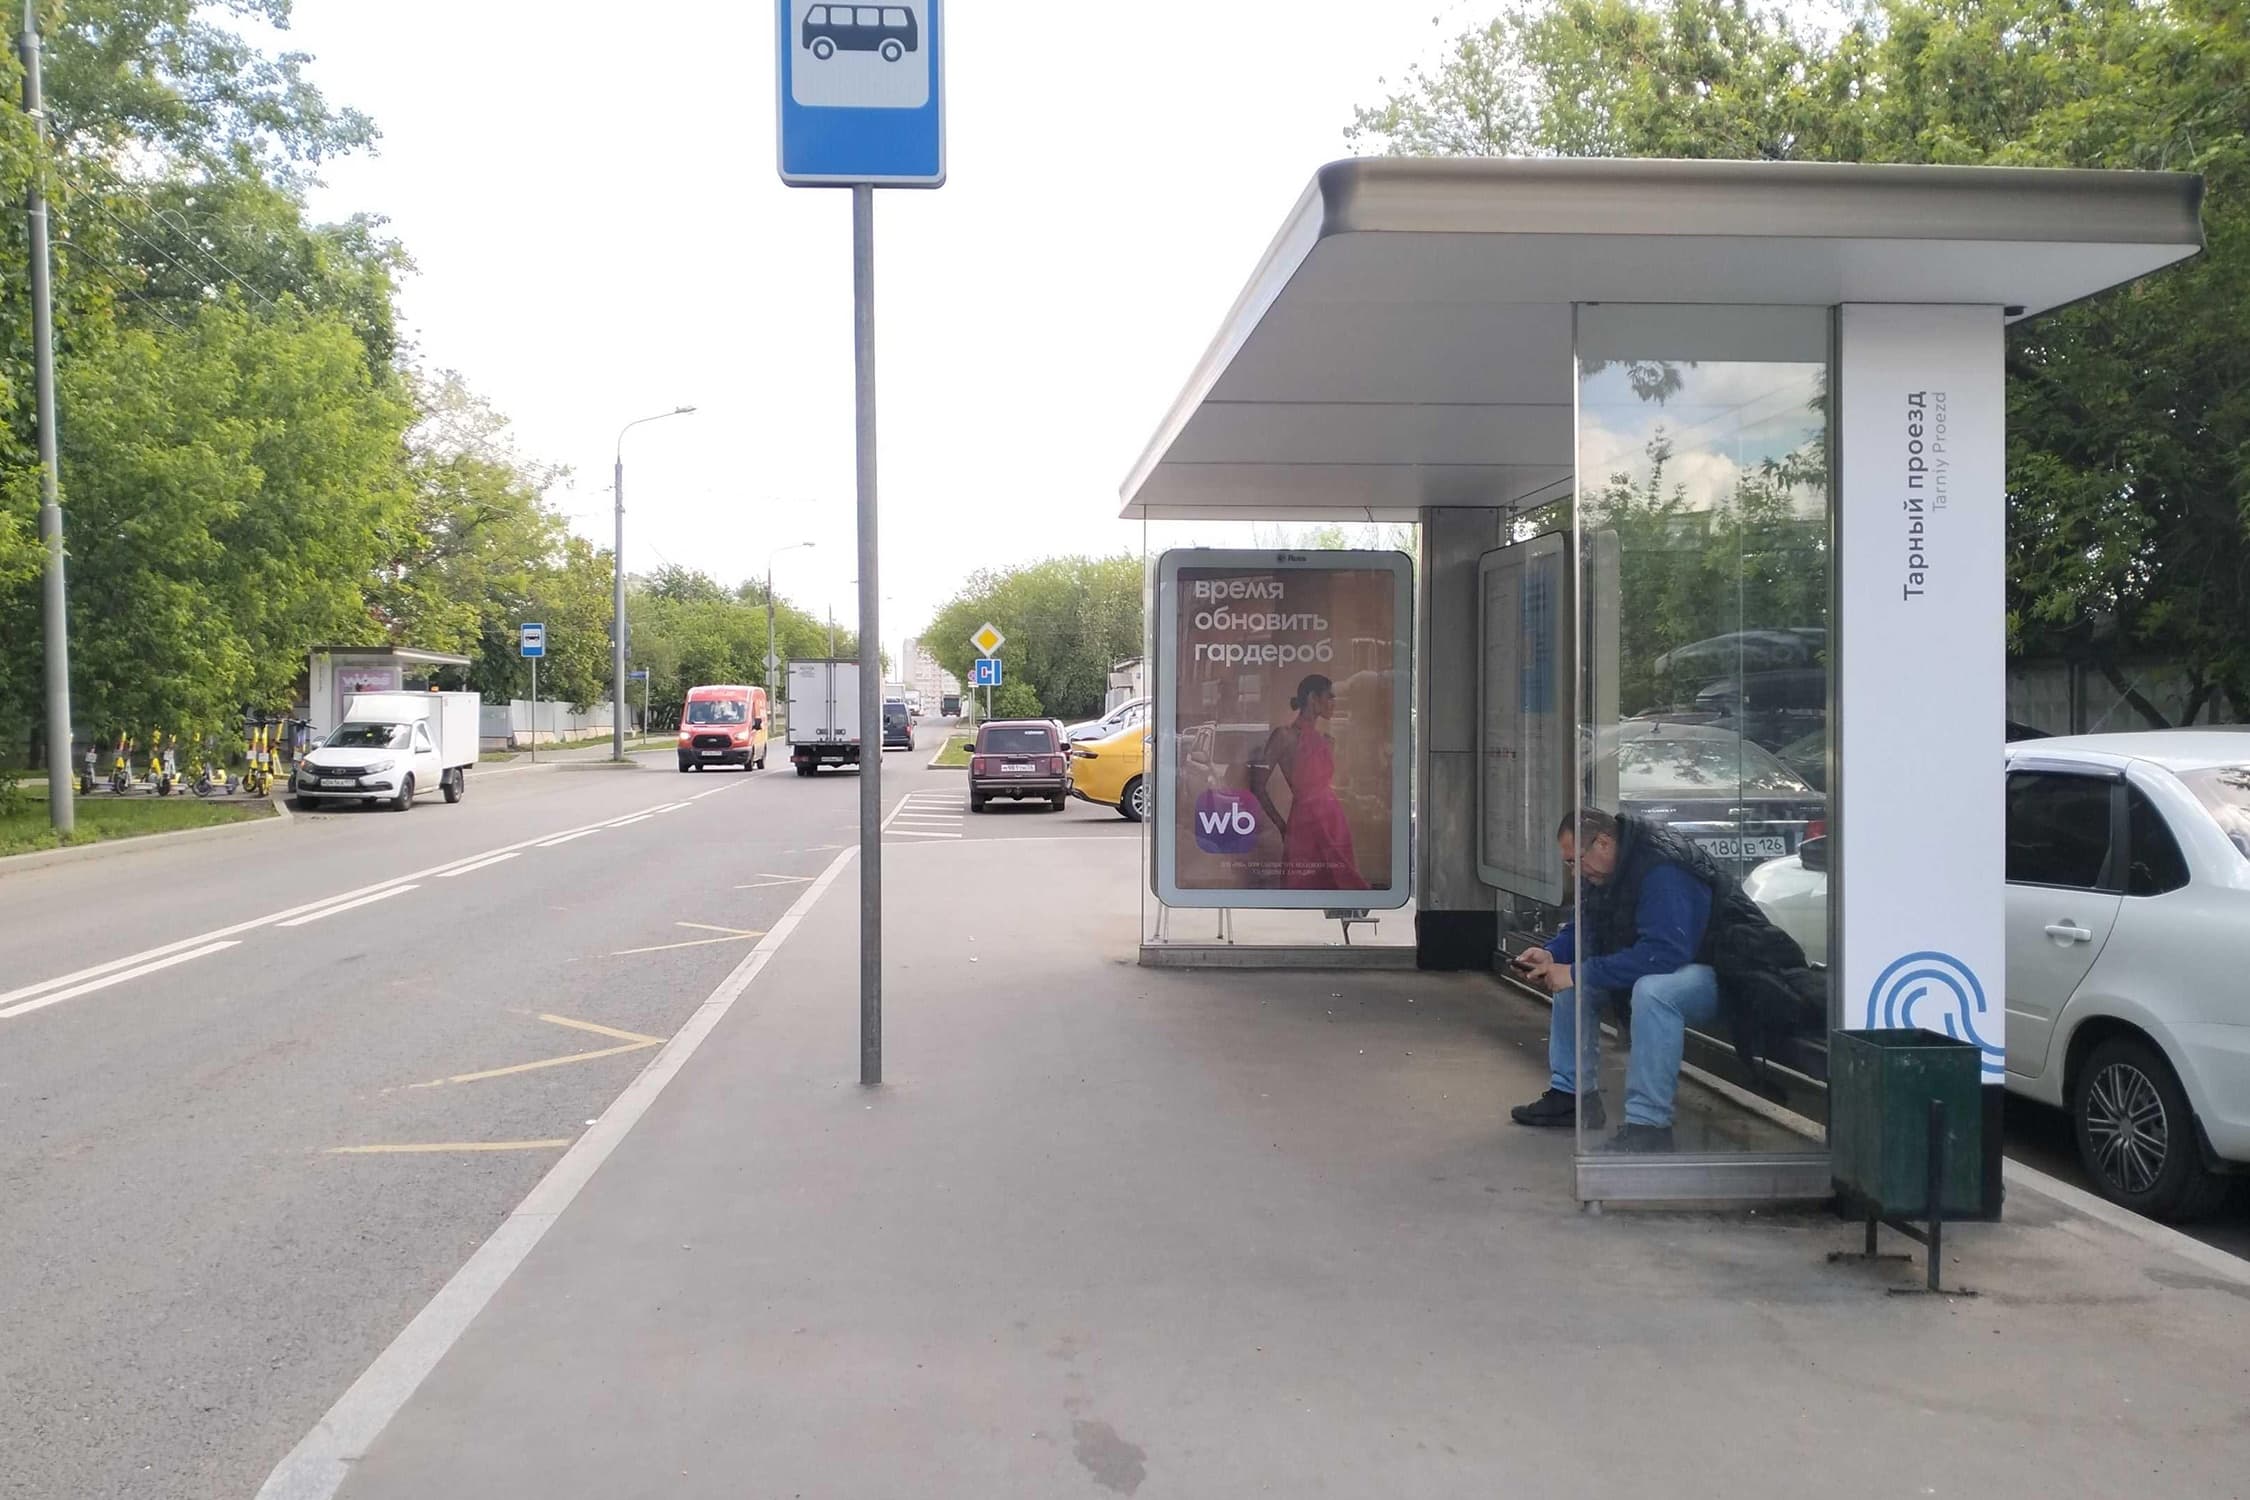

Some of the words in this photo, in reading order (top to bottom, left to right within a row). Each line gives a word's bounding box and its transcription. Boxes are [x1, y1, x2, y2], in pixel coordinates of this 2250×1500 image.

[1908, 391, 1929, 489] проезд
[1932, 391, 1947, 453] Proezd
[1932, 458, 1950, 512] Tarniy
[1903, 498, 1929, 601] Тарный
[1194, 580, 1284, 604] время
[1194, 606, 1329, 631] обновить
[1194, 638, 1334, 667] гардероб
[1199, 802, 1256, 835] wb
